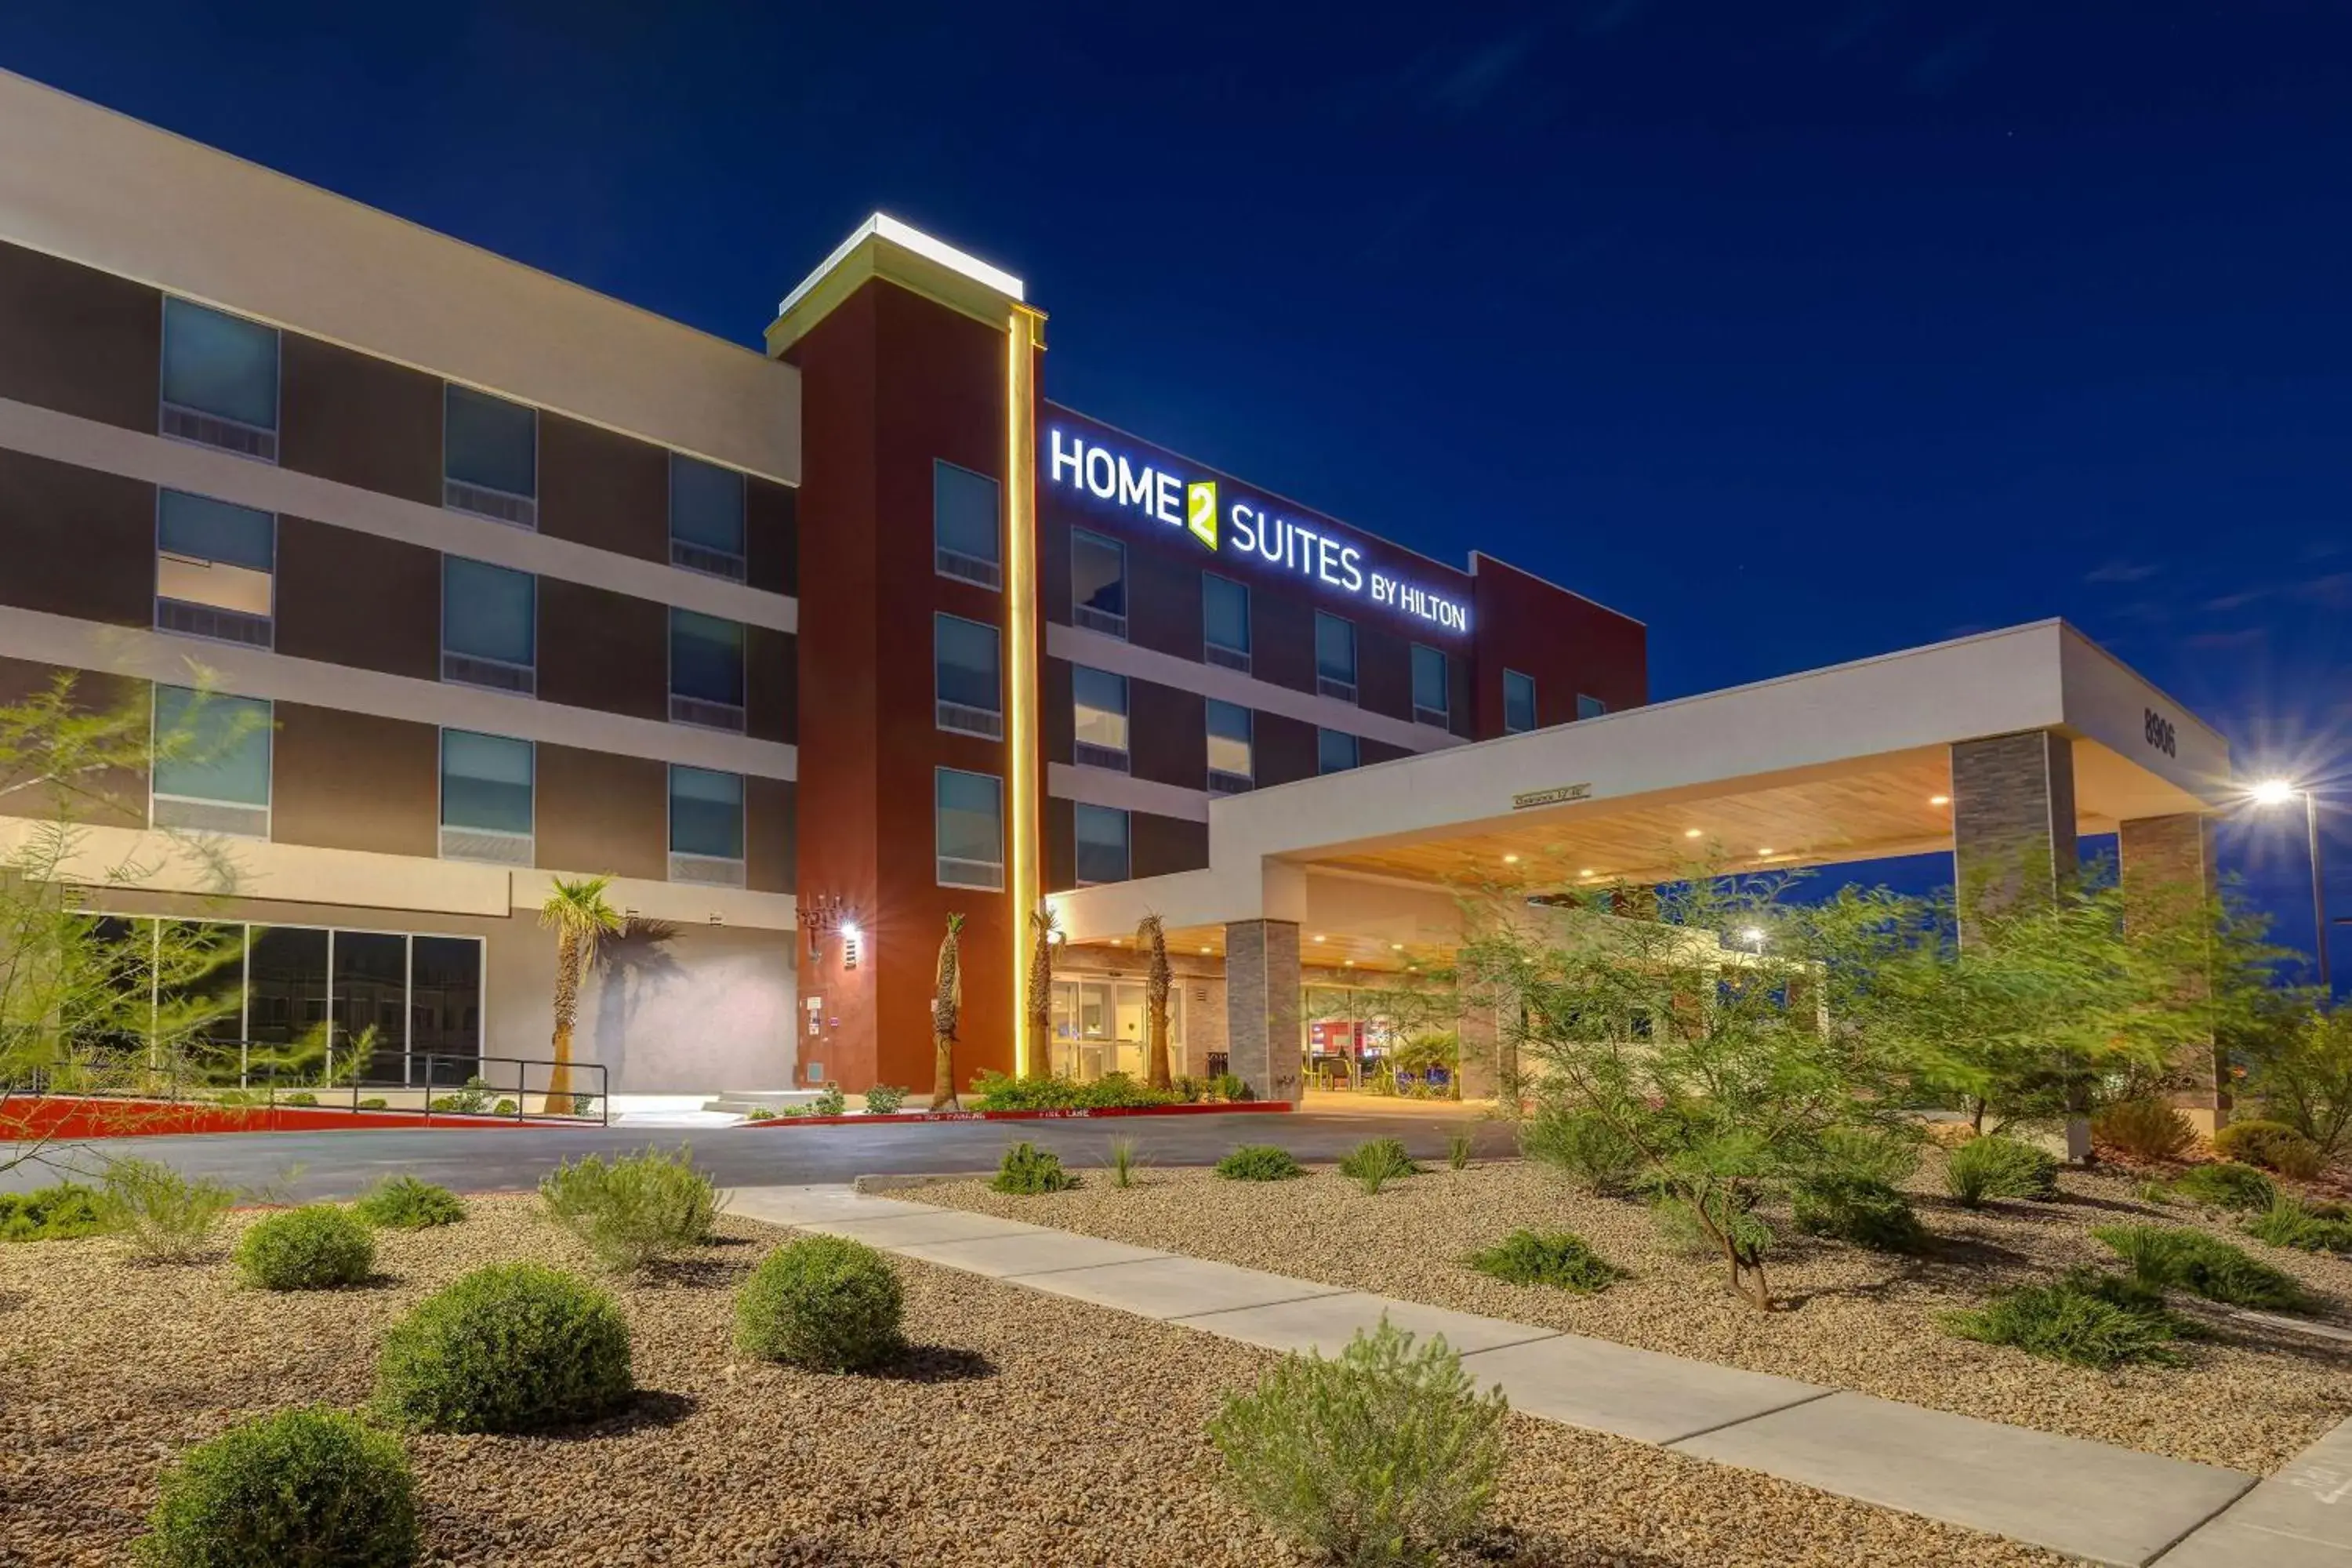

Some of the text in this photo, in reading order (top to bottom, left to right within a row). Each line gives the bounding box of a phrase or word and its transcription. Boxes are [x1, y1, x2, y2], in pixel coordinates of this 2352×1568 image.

[1051, 429, 1182, 526] HOME
[1231, 504, 1363, 591] SUITES
[1371, 573, 1465, 631] BY HILTON
[2144, 707, 2176, 759] 8906
